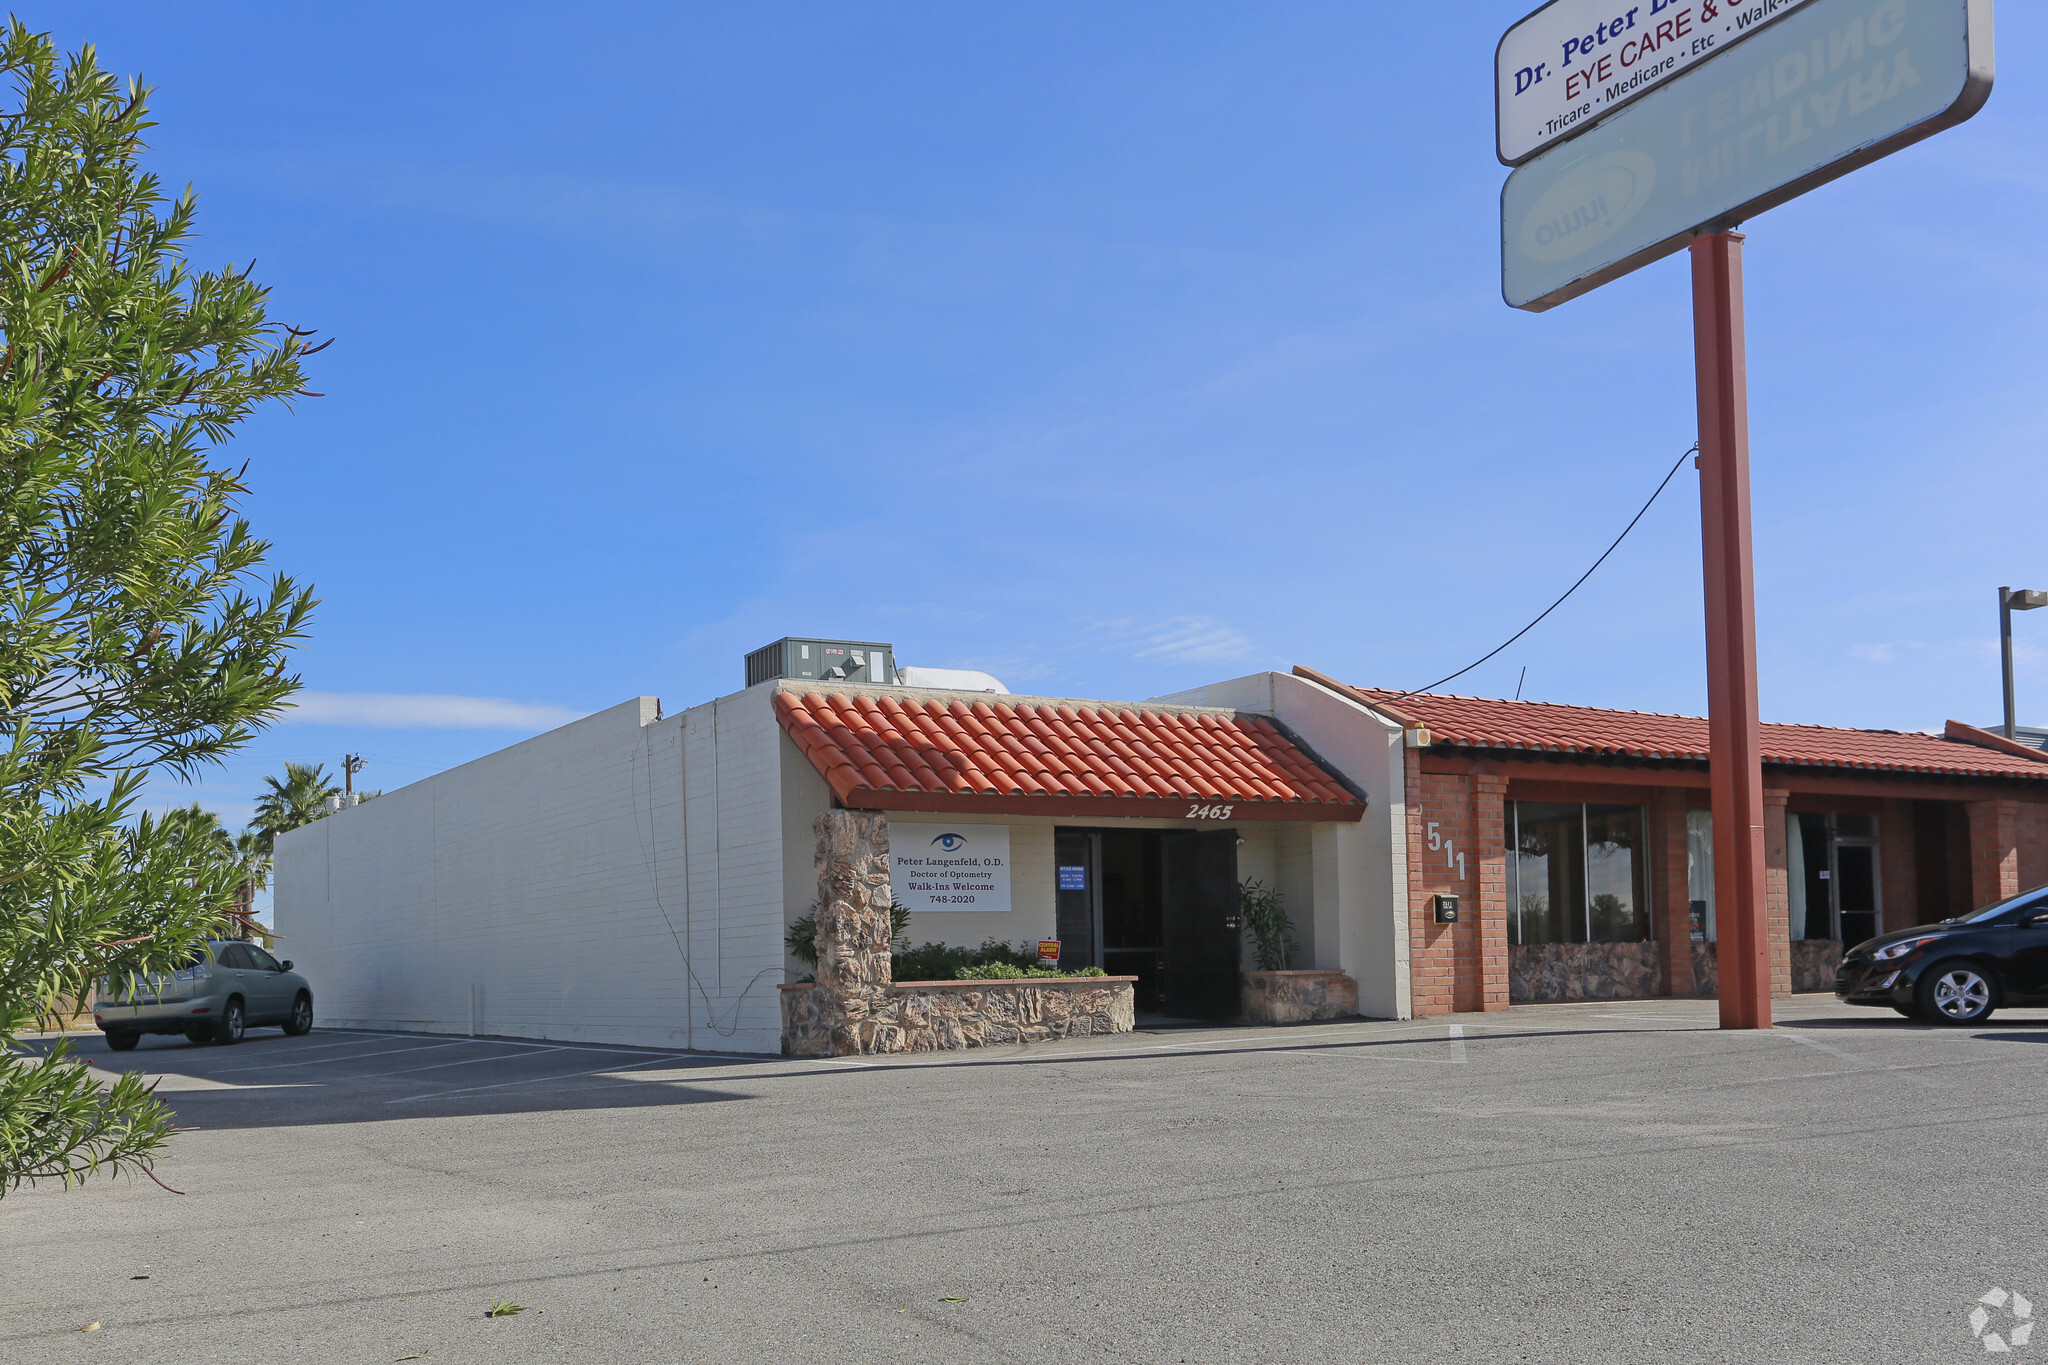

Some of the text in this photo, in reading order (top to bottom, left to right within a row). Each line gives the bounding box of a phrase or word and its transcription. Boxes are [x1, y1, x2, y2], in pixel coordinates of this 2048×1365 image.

[1514, 62, 1552, 97] Dr.
[1562, 6, 1639, 68] Peter
[1566, 0, 1719, 101] EYE CARE &
[1545, 0, 1793, 135] Tricare Medicare Etc Walk-
[1186, 804, 1234, 819] 2465
[897, 857, 1004, 868] Peter Langenfeld, O.D.
[910, 870, 993, 880] Doctor of Optometry
[908, 882, 995, 891] Walk-Ins Welcome
[929, 895, 976, 904] 748-2020
